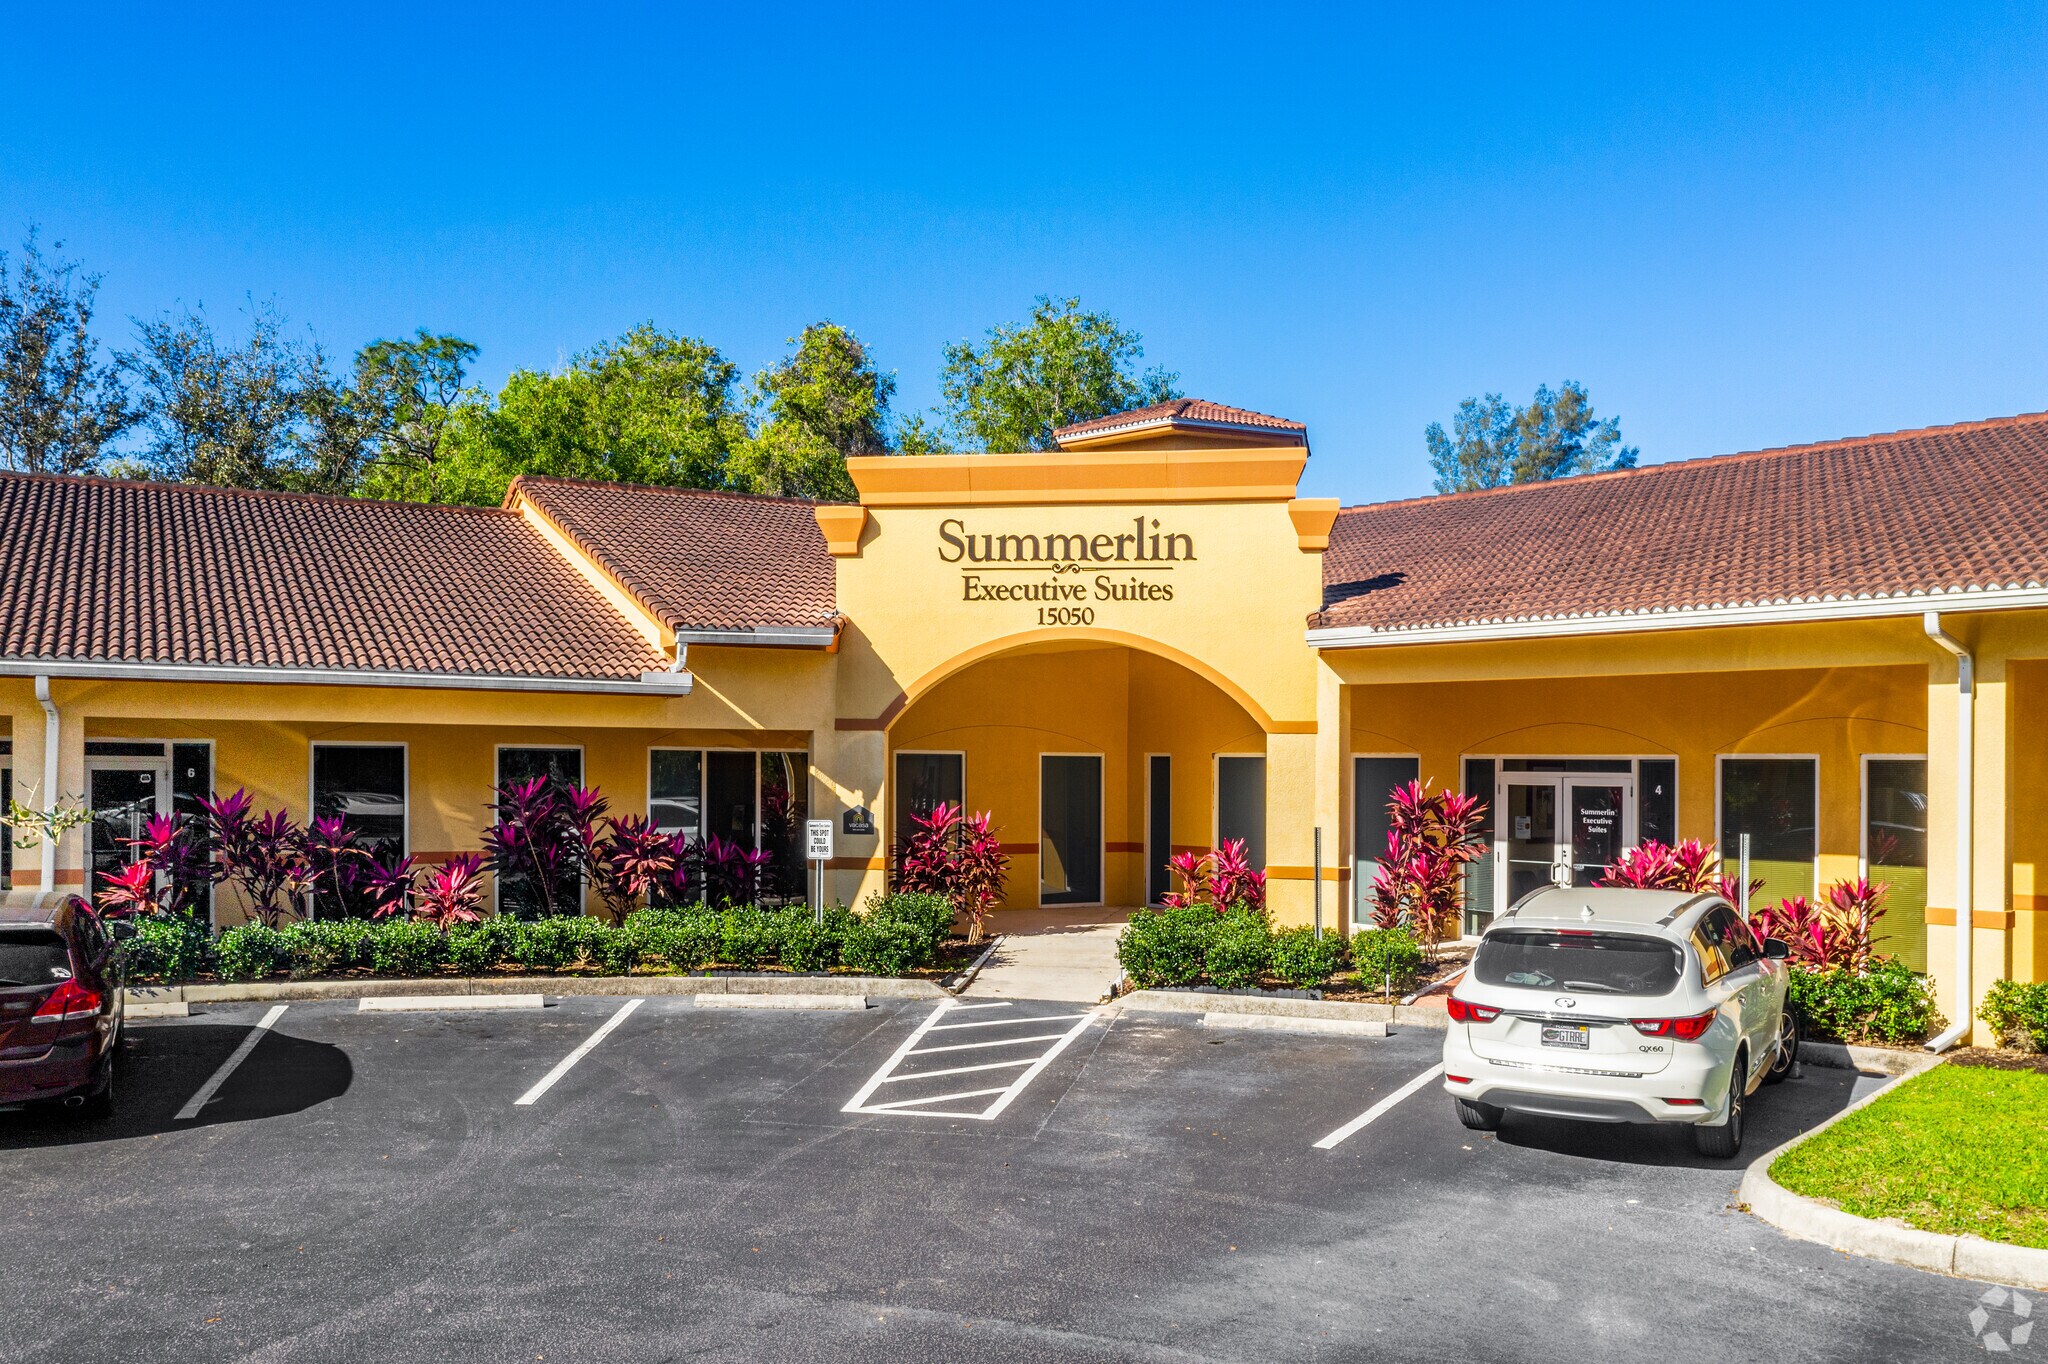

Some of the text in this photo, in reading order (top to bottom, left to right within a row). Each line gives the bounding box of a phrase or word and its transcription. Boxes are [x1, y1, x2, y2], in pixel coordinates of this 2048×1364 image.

[938, 515, 1197, 563] Summerlin
[962, 575, 1174, 602] Executive Suites
[1037, 607, 1095, 626] 15050
[188, 768, 195, 778] 6
[1655, 785, 1662, 796] 4
[1580, 808, 1615, 817] Summerlin
[1582, 817, 1613, 825] Executive
[1588, 826, 1607, 834] Suites
[1638, 1045, 1664, 1053] QX60
